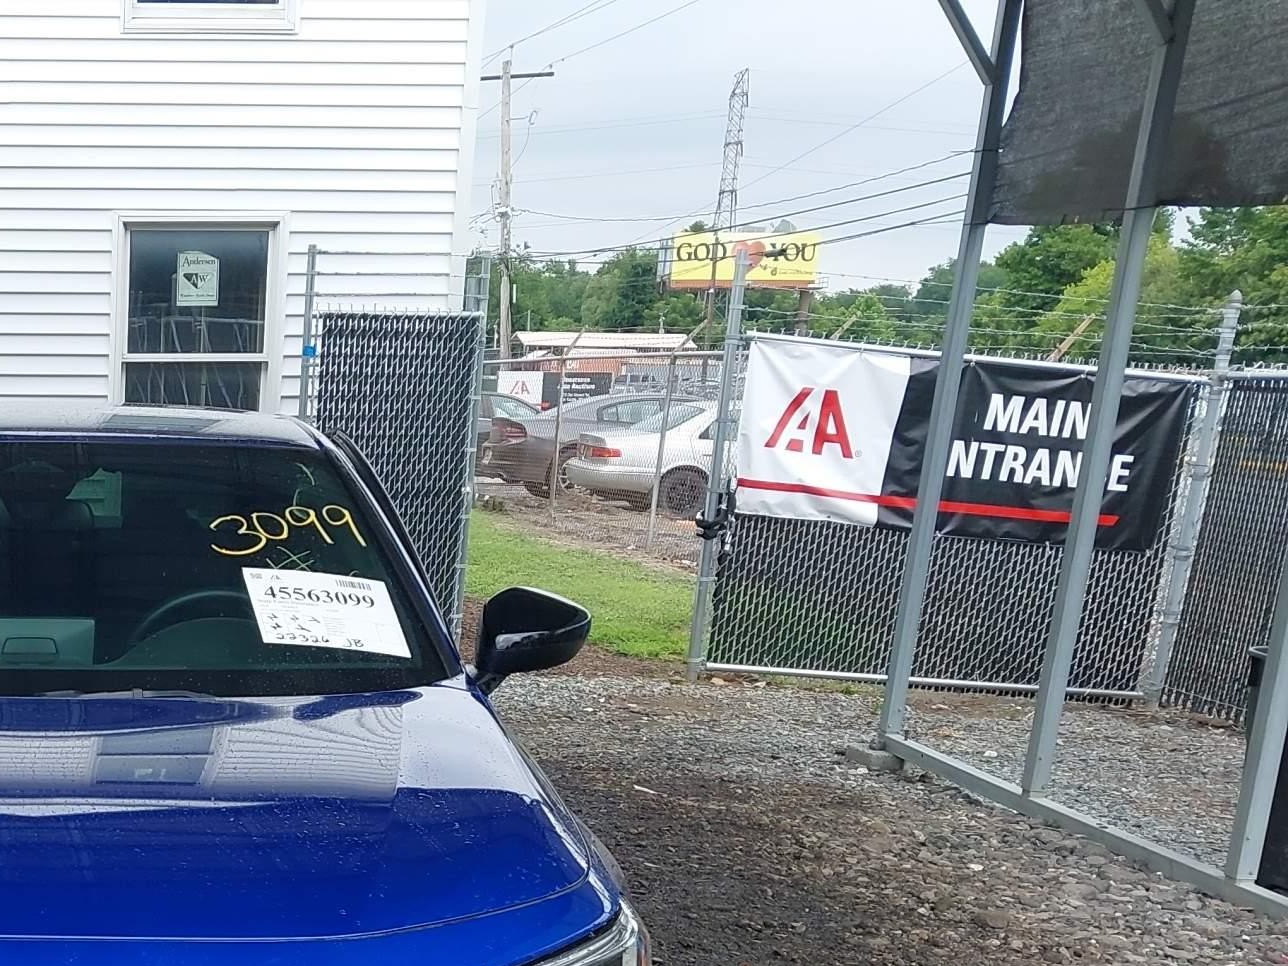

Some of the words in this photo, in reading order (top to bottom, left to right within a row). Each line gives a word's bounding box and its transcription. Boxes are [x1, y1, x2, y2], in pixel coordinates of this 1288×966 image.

[676, 242, 727, 262] GOD
[983, 393, 1092, 440] MAIN
[946, 439, 1135, 492] NTRANE
[209, 504, 368, 556] 3099
[264, 585, 376, 609] 45563099
